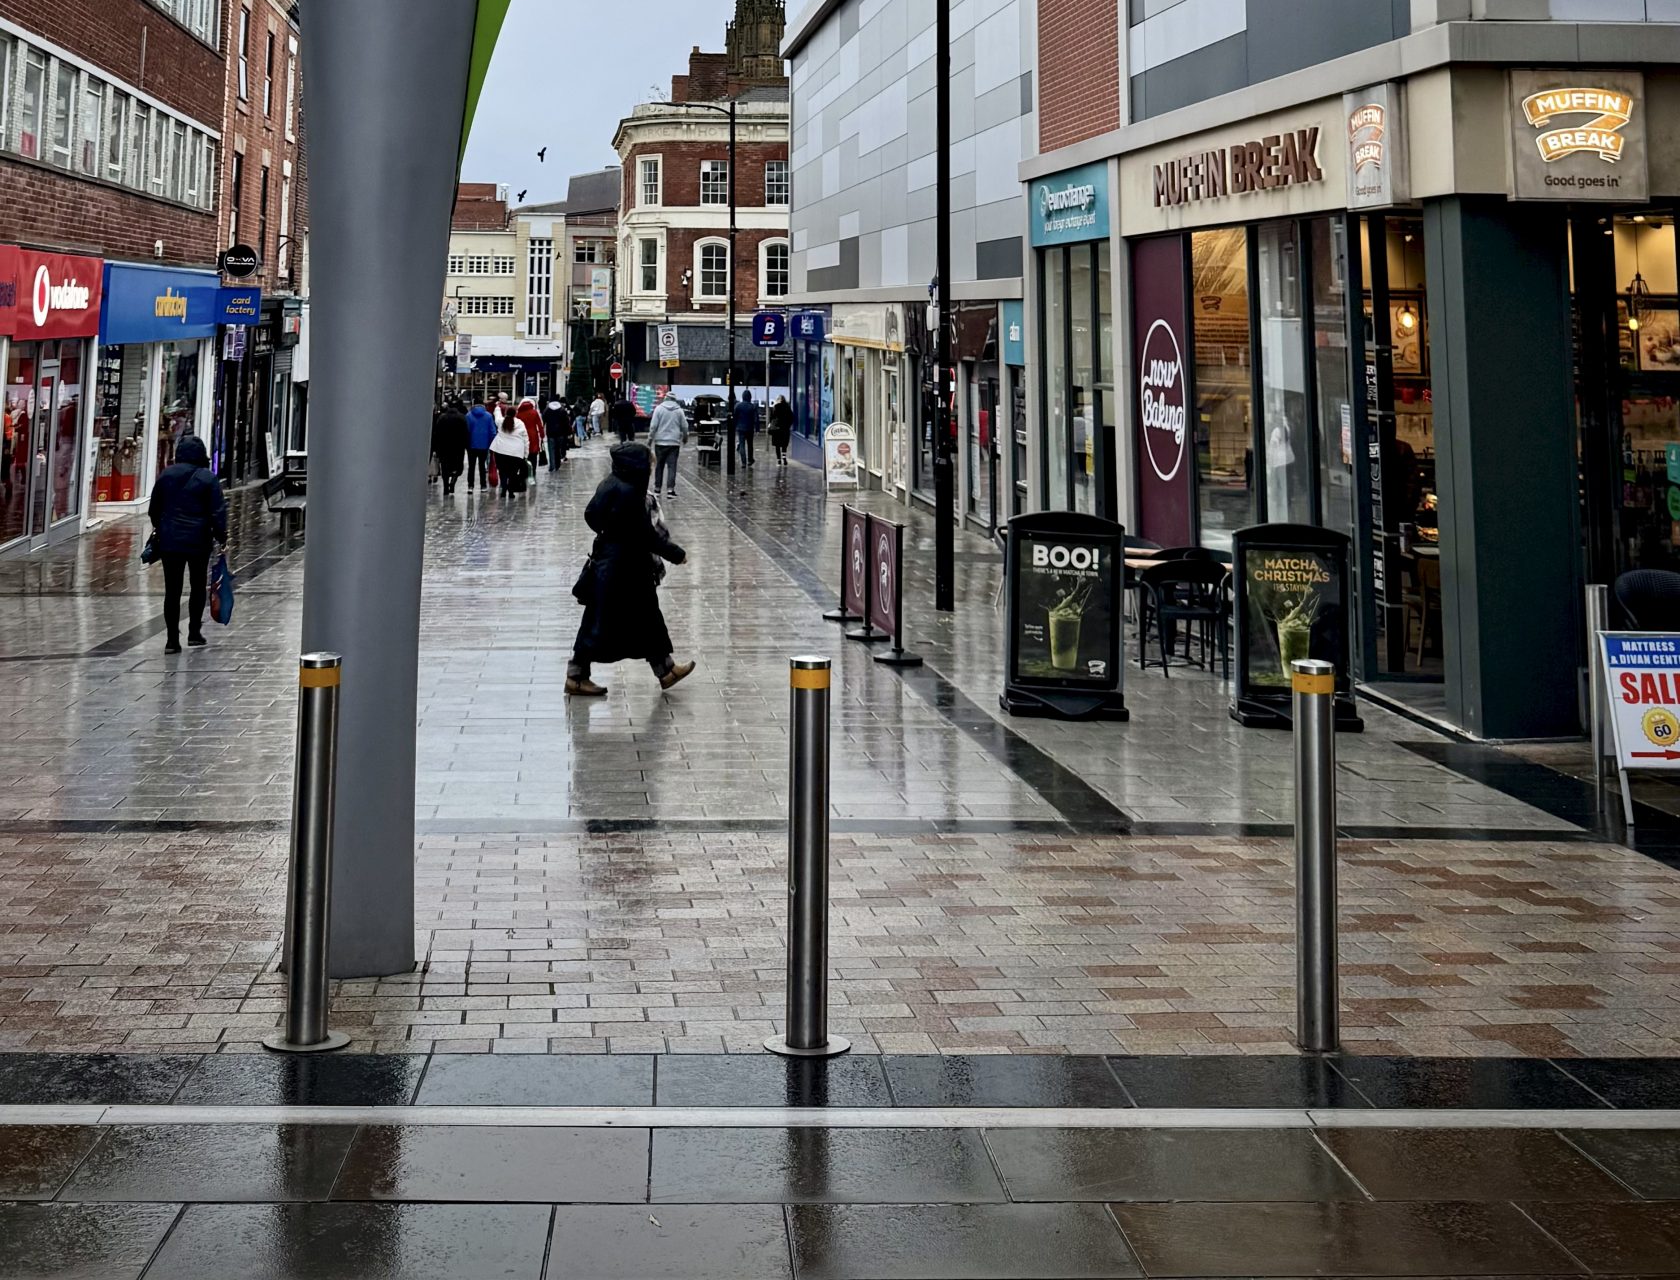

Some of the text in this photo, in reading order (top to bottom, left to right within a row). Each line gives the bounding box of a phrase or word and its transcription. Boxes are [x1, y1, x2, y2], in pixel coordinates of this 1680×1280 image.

[1535, 93, 1622, 113] MUFFIN
[1350, 108, 1381, 131] MUFFIN
[697, 126, 748, 138] HOTL
[1546, 131, 1616, 151] BREAK
[1355, 144, 1380, 164] BREAK
[1152, 126, 1323, 208] MUFFIN BREAK
[1544, 175, 1576, 187] Good
[1578, 177, 1605, 189] goes
[231, 296, 252, 305] card
[225, 304, 256, 316] factory
[1146, 358, 1178, 388] now
[1143, 388, 1185, 445] Baking
[1032, 544, 1100, 570] BOO!
[1253, 570, 1330, 583] CHRISTMAS
[1621, 641, 1676, 652] MATTRESS
[1610, 655, 1618, 664] &
[1619, 654, 1651, 665] DIVAN
[1653, 723, 1672, 738] 60
